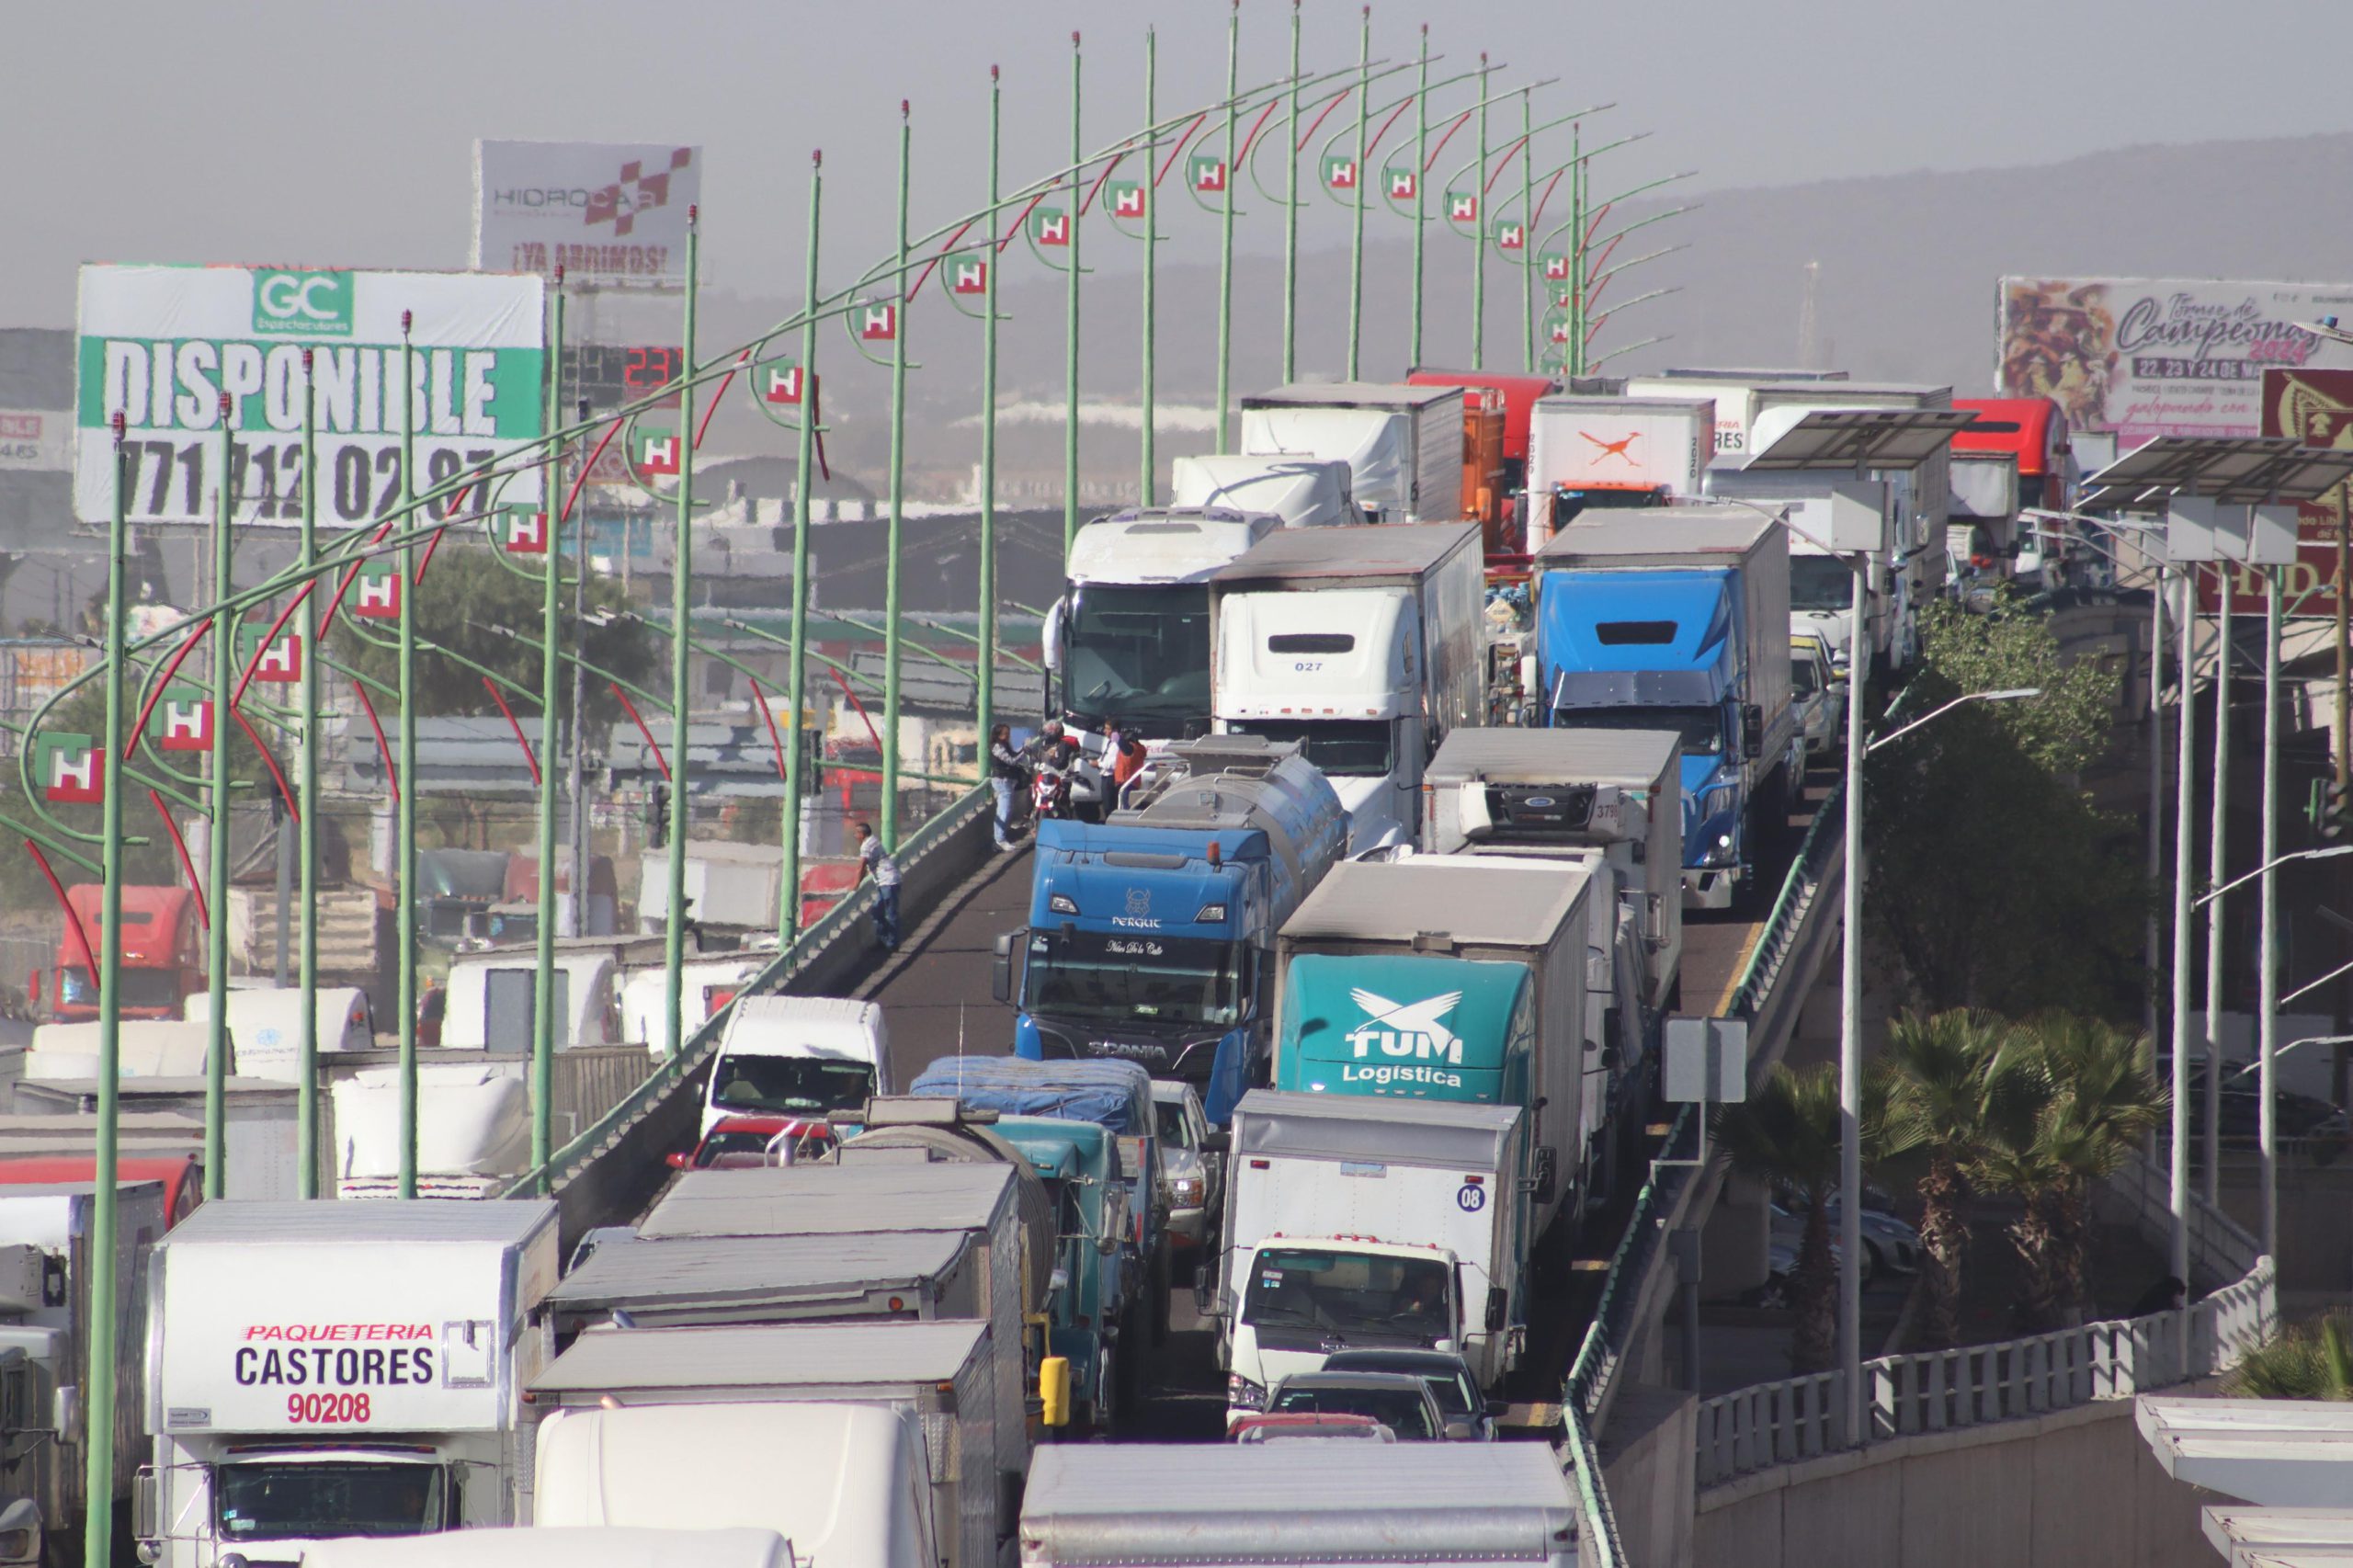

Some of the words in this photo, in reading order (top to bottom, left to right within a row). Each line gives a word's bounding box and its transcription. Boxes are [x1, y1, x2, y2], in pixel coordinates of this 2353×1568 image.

[260, 274, 338, 319] GC
[2165, 360, 2184, 378] 23
[2188, 361, 2197, 377] Y
[2200, 361, 2218, 378] 24
[103, 338, 496, 437] DISPONIBLE
[1294, 663, 1324, 672] 027
[1087, 1040, 1168, 1059] SCANIA
[1345, 1030, 1463, 1064] TUM
[1343, 1064, 1461, 1088] Logística
[1461, 1187, 1481, 1209] 08
[243, 1324, 434, 1342] PAQUETERIA
[235, 1346, 433, 1386] CASTORES
[287, 1392, 371, 1423] 90208
